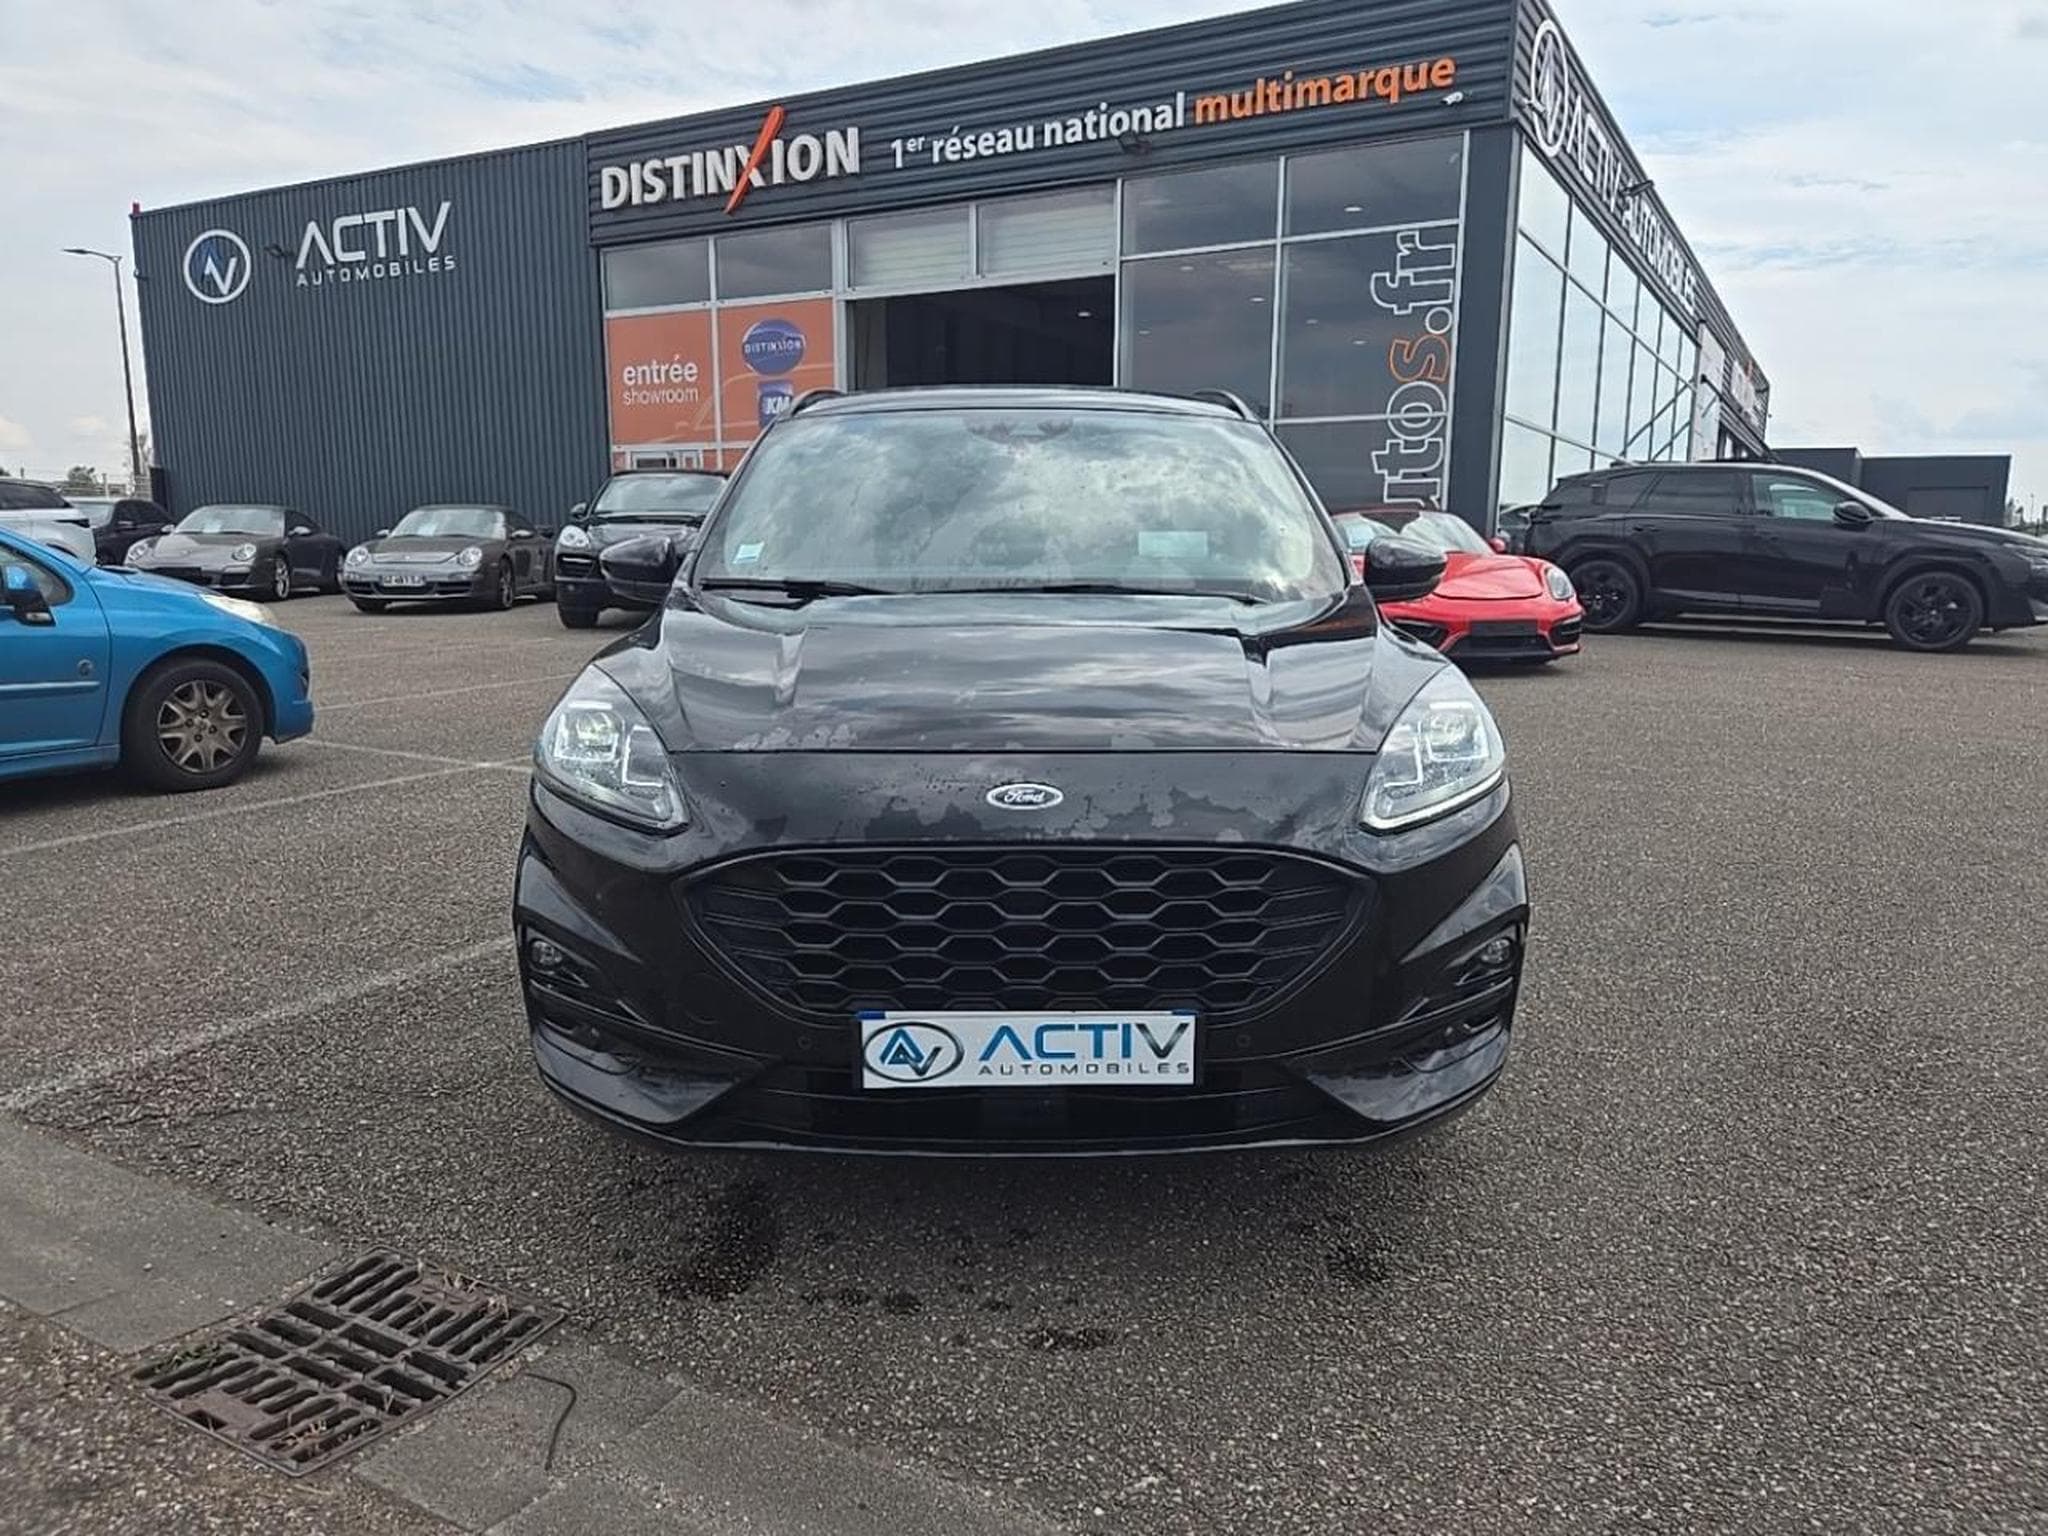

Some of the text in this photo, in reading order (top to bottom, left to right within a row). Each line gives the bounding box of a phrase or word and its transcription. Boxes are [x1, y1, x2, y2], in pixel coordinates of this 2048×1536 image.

[932, 125, 1034, 163] réseau
[1043, 91, 1185, 147] national
[1195, 57, 1456, 124] multimarque
[601, 105, 860, 214] DISTINXION
[296, 201, 451, 269] ACTIV
[296, 255, 457, 287] AUTOMOBILES
[622, 354, 699, 386] entrée
[622, 387, 699, 406] showroom
[1004, 789, 1046, 803] Ford
[978, 1023, 1190, 1062] ACTIV
[978, 1062, 1190, 1076] AUTOMOBILES
